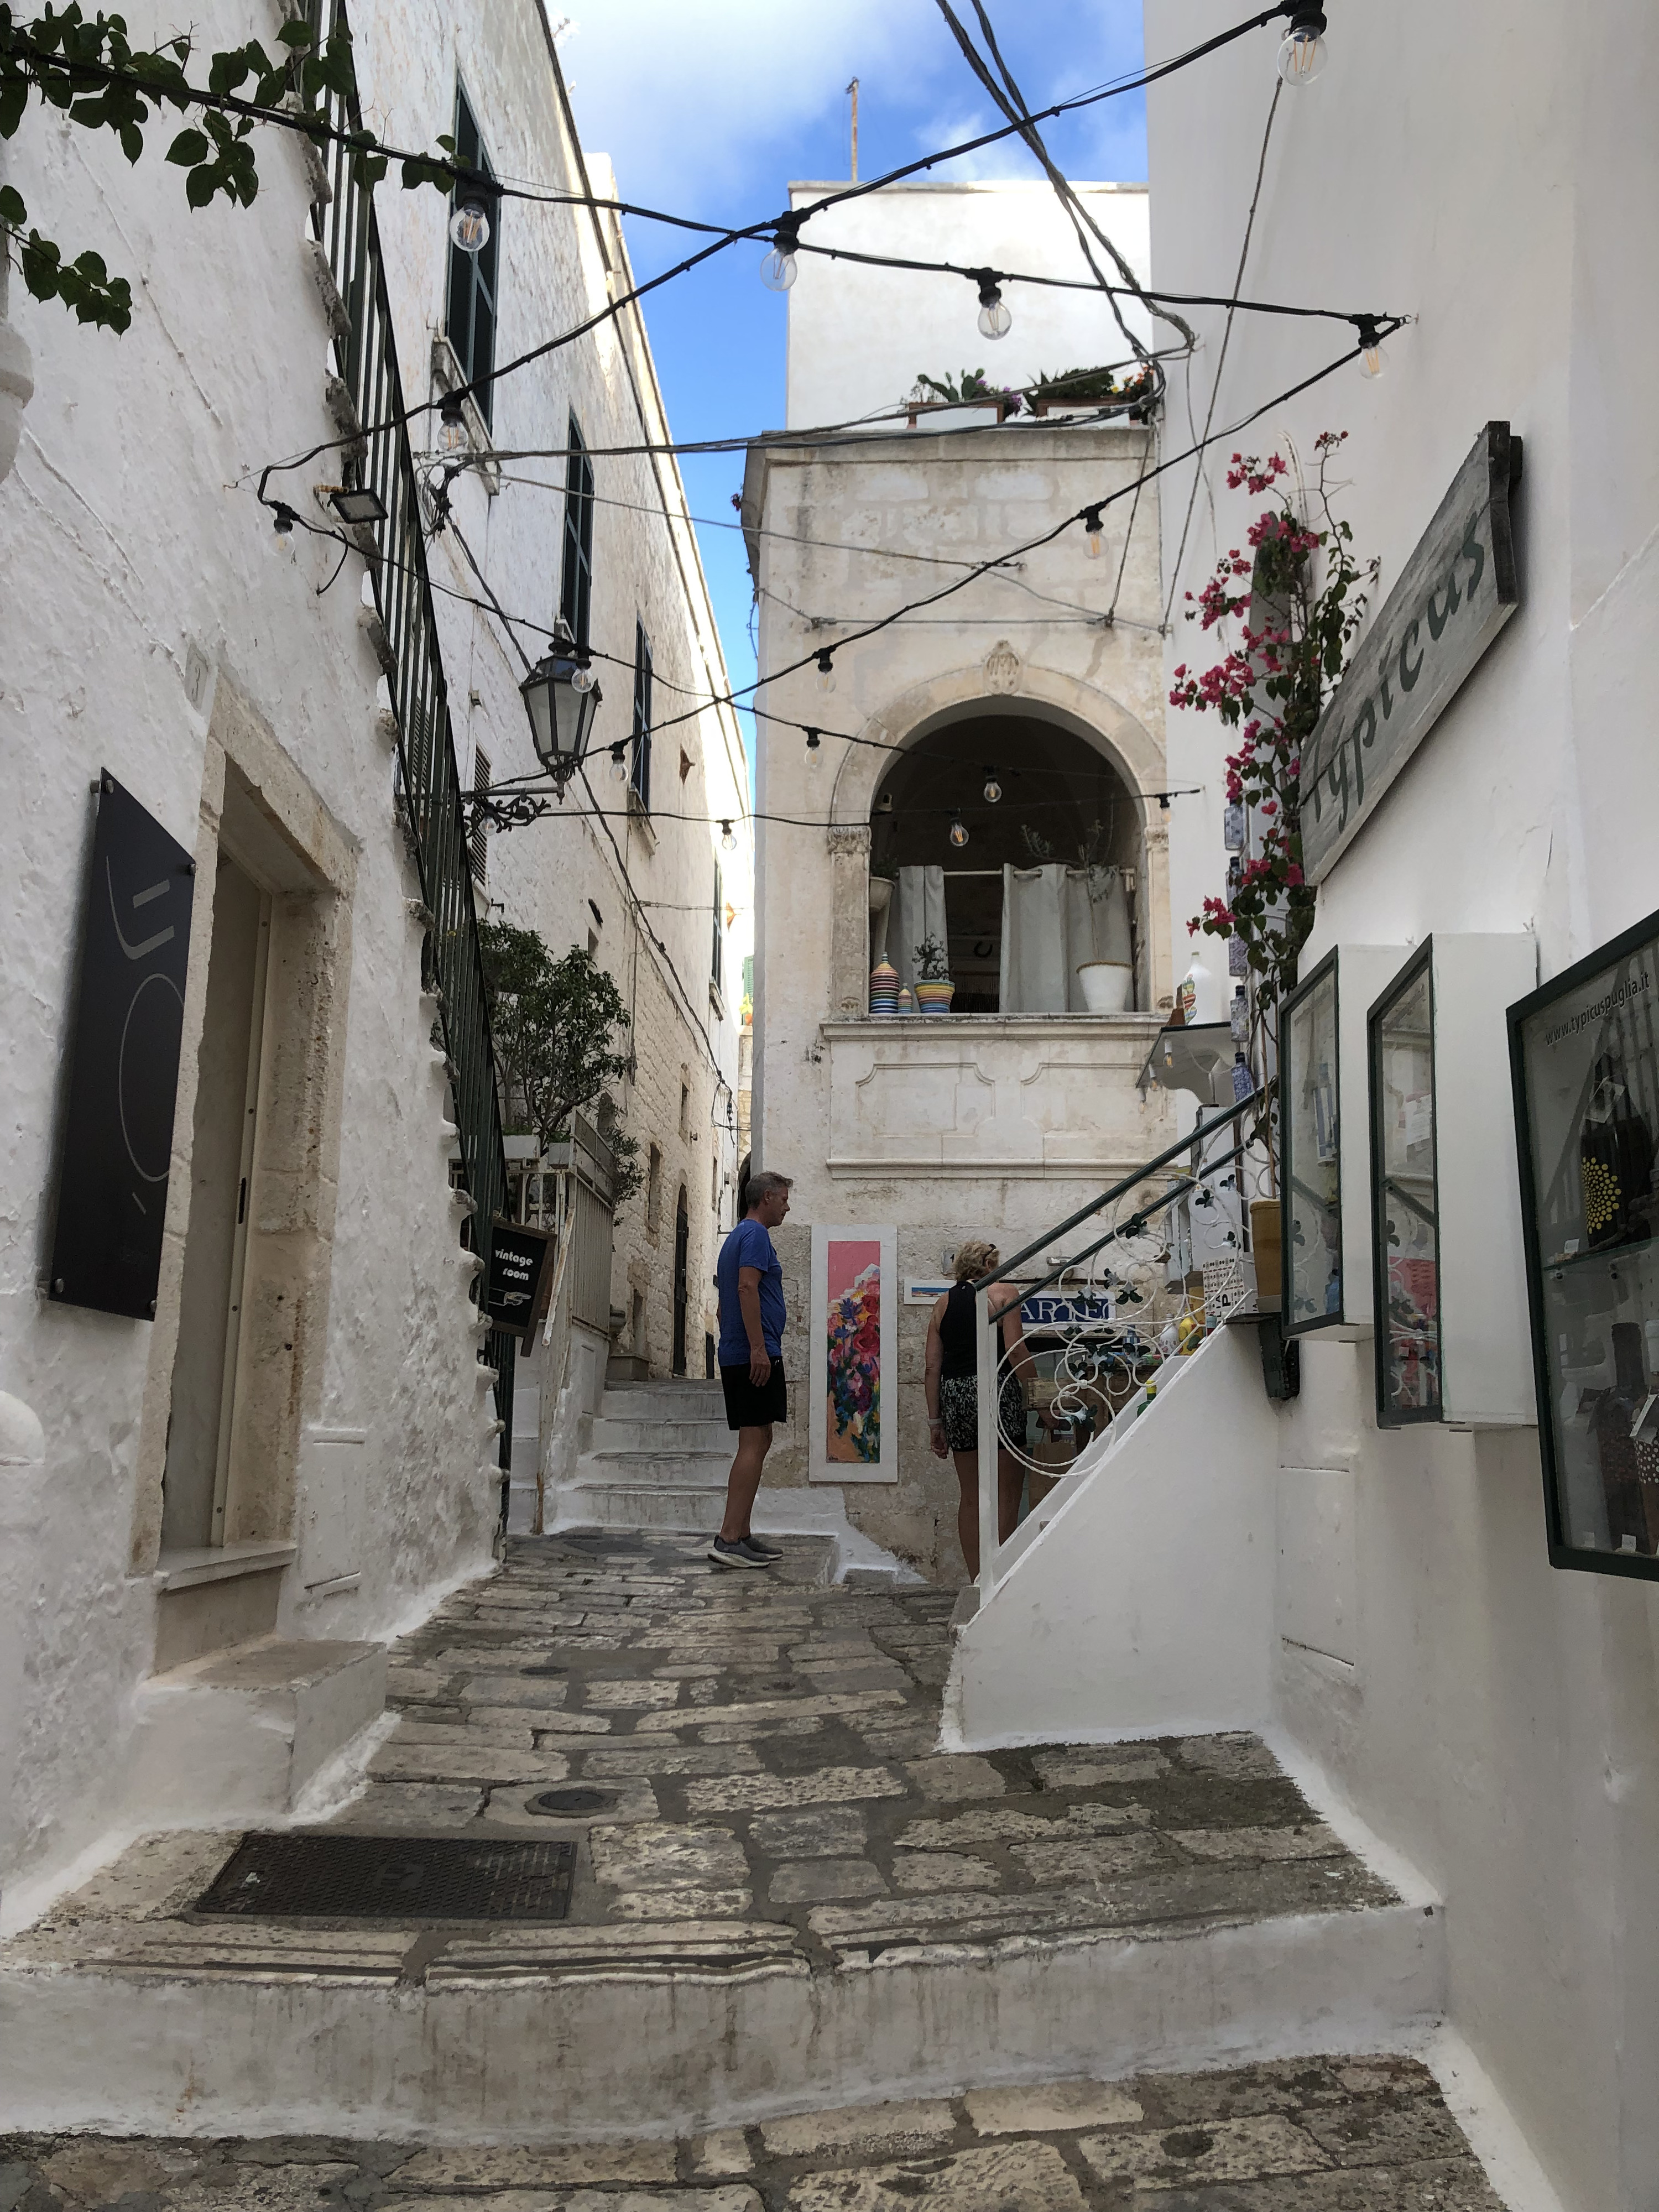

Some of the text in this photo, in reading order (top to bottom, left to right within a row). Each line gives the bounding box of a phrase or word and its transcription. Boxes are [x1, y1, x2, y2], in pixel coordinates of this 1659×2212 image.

[1302, 510, 1485, 834] Typicus
[1546, 972, 1650, 1046] www.typicuspuglia.it
[495, 1249, 533, 1267] vintage
[503, 1268, 529, 1281] room
